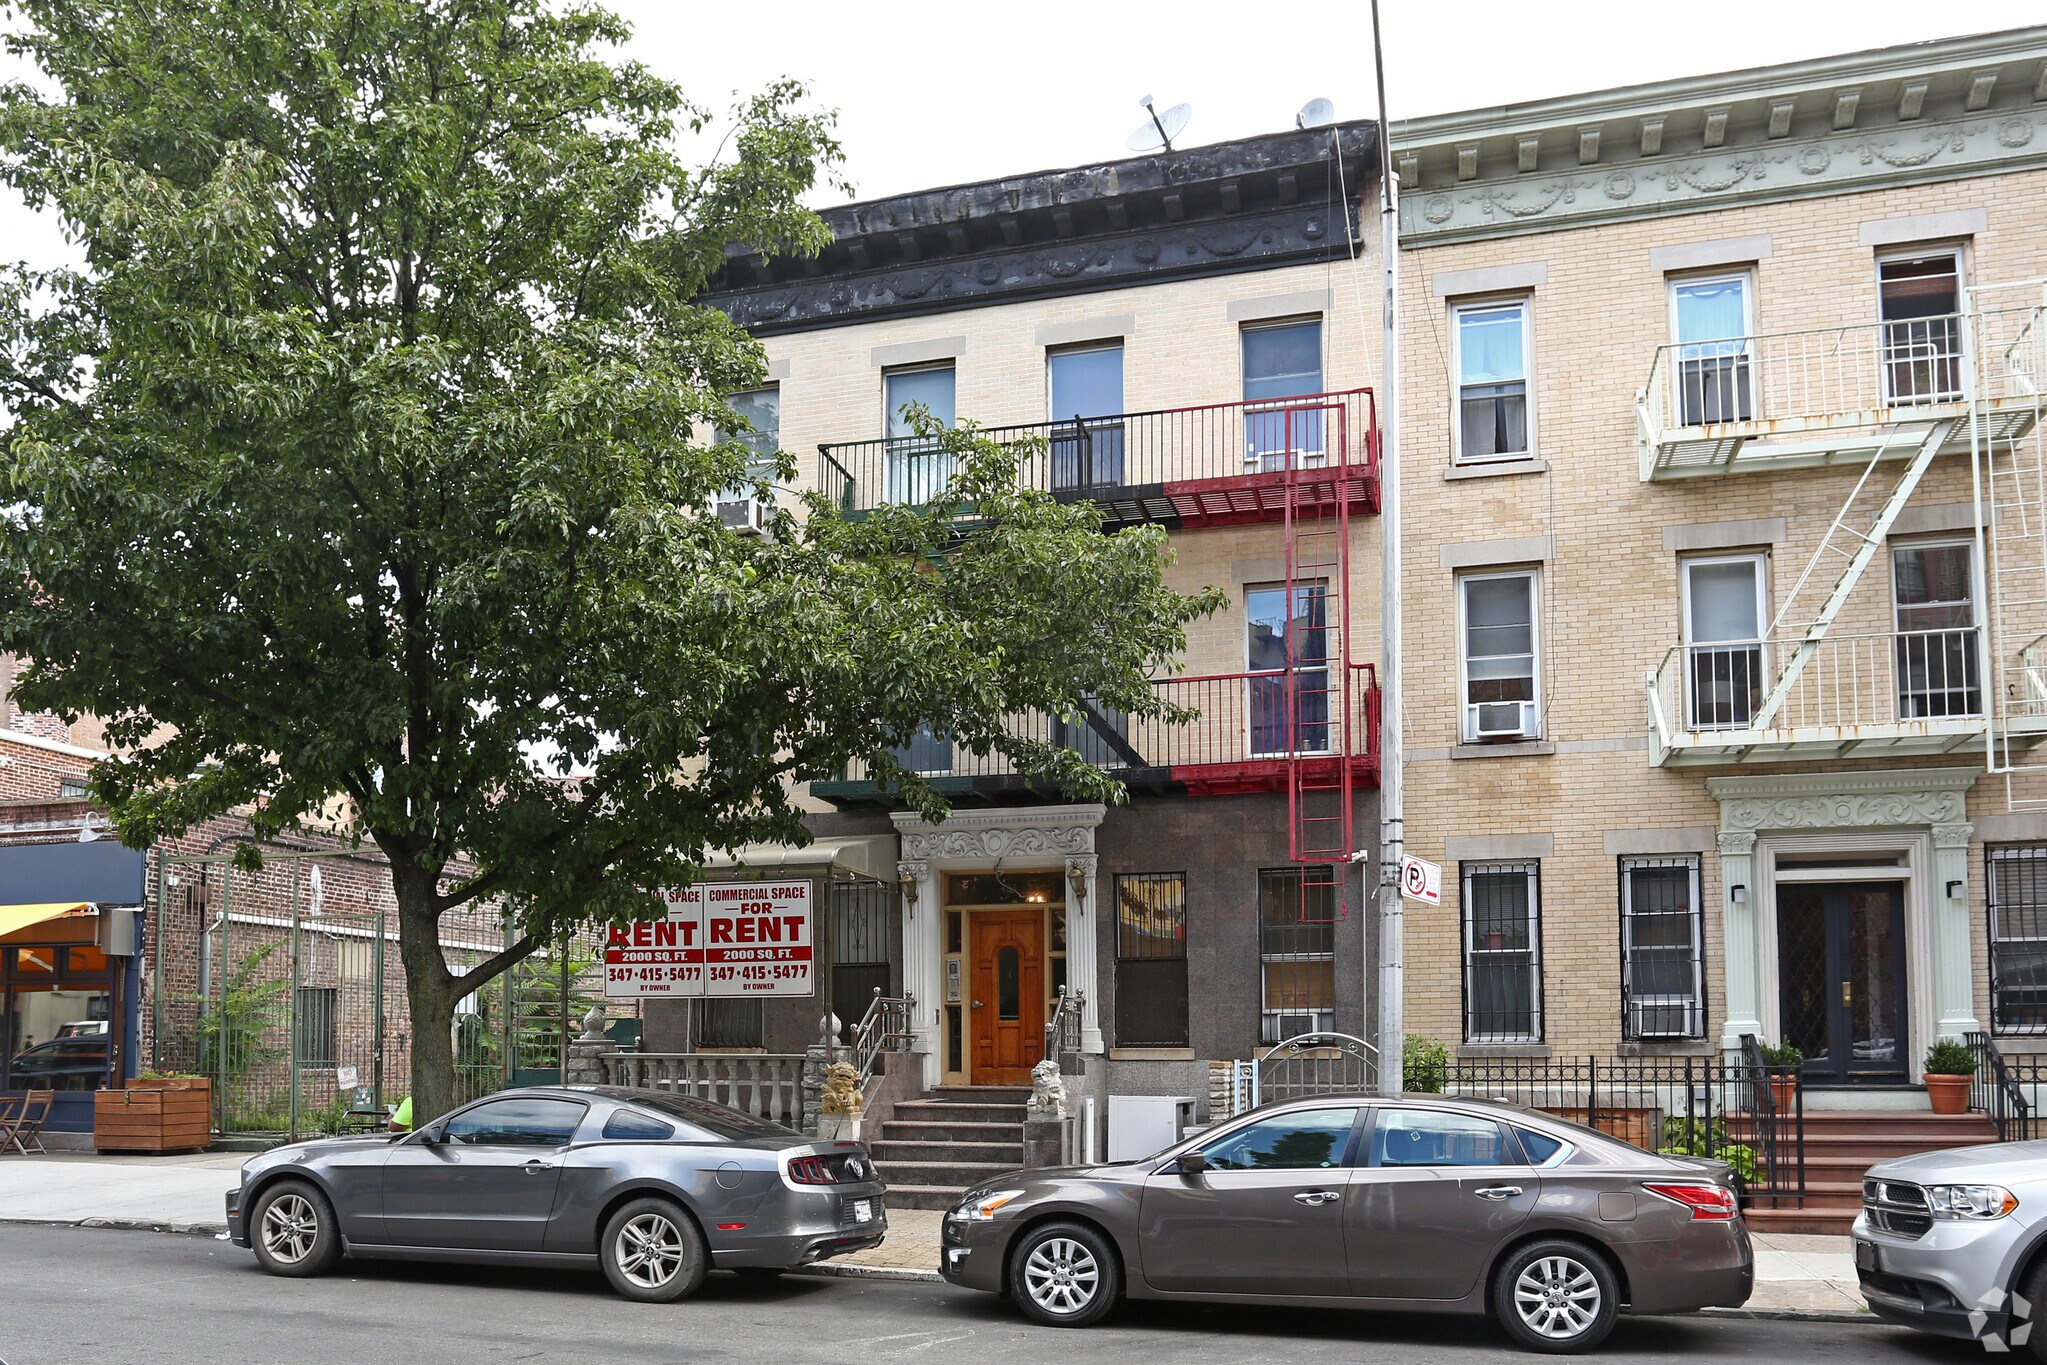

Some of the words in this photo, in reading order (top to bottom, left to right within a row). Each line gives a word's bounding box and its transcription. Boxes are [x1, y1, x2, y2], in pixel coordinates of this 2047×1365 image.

[709, 888, 769, 902] COMMERCIAL
[771, 886, 805, 900] SPACE
[741, 902, 773, 914] FOR
[609, 921, 698, 946] RENT
[710, 916, 805, 943] RENT
[622, 951, 652, 962] 2000
[674, 951, 688, 961] FT.
[723, 950, 755, 960] 2000
[778, 948, 793, 959] FT.
[343, 1069, 352, 1077] NO
